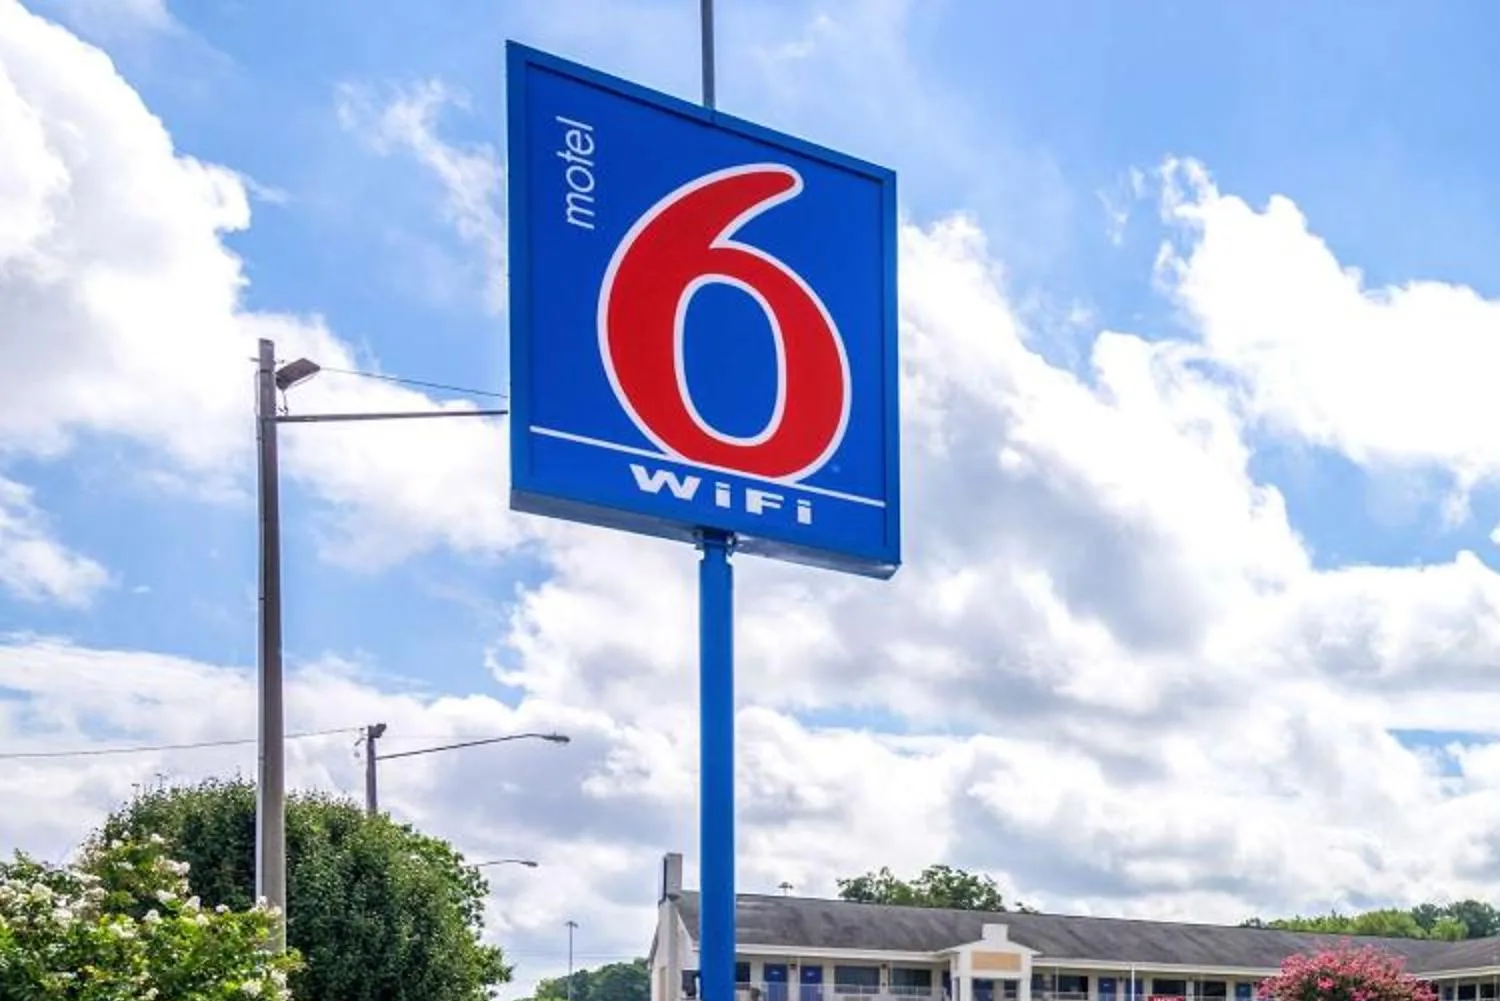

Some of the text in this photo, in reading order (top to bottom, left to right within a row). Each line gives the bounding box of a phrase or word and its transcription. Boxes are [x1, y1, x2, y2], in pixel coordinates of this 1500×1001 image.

[556, 115, 595, 230] motel
[597, 162, 852, 484] 6
[629, 463, 812, 524] WiFi
